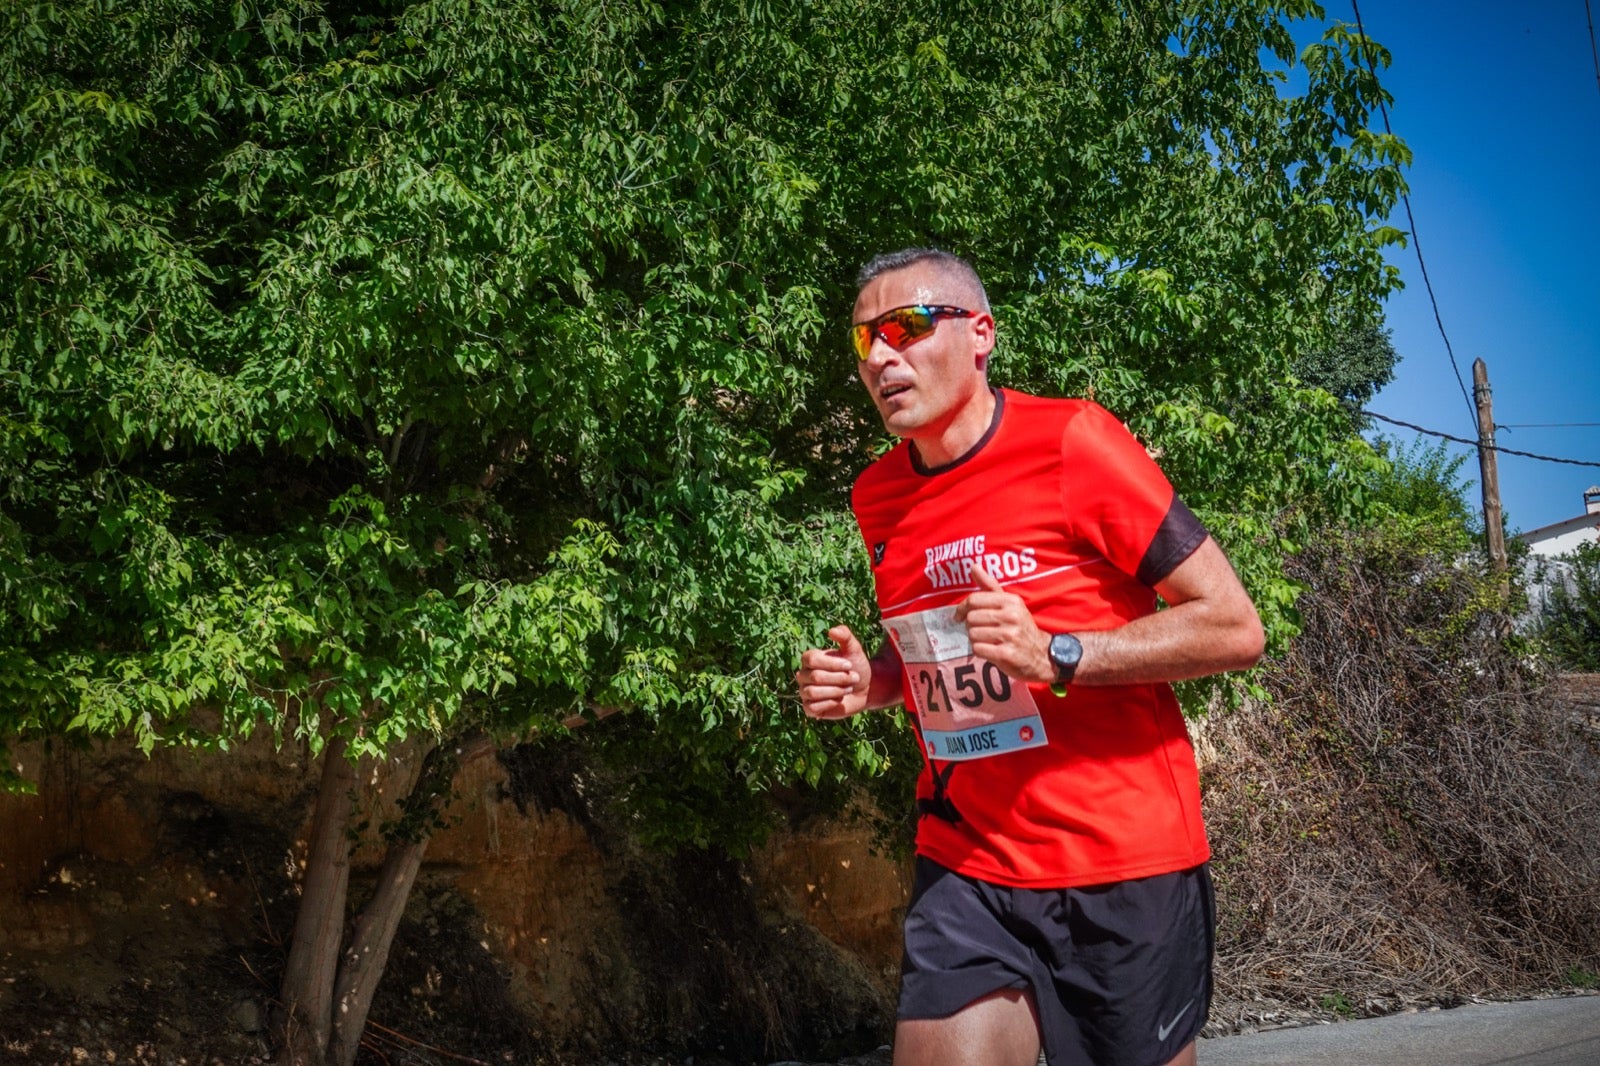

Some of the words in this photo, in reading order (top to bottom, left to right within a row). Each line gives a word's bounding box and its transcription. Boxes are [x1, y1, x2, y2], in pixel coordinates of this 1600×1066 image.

[925, 535, 985, 566] RUNNING
[919, 660, 1012, 713] 2150
[945, 736, 968, 755] JUAN
[968, 730, 999, 752] JOSE
